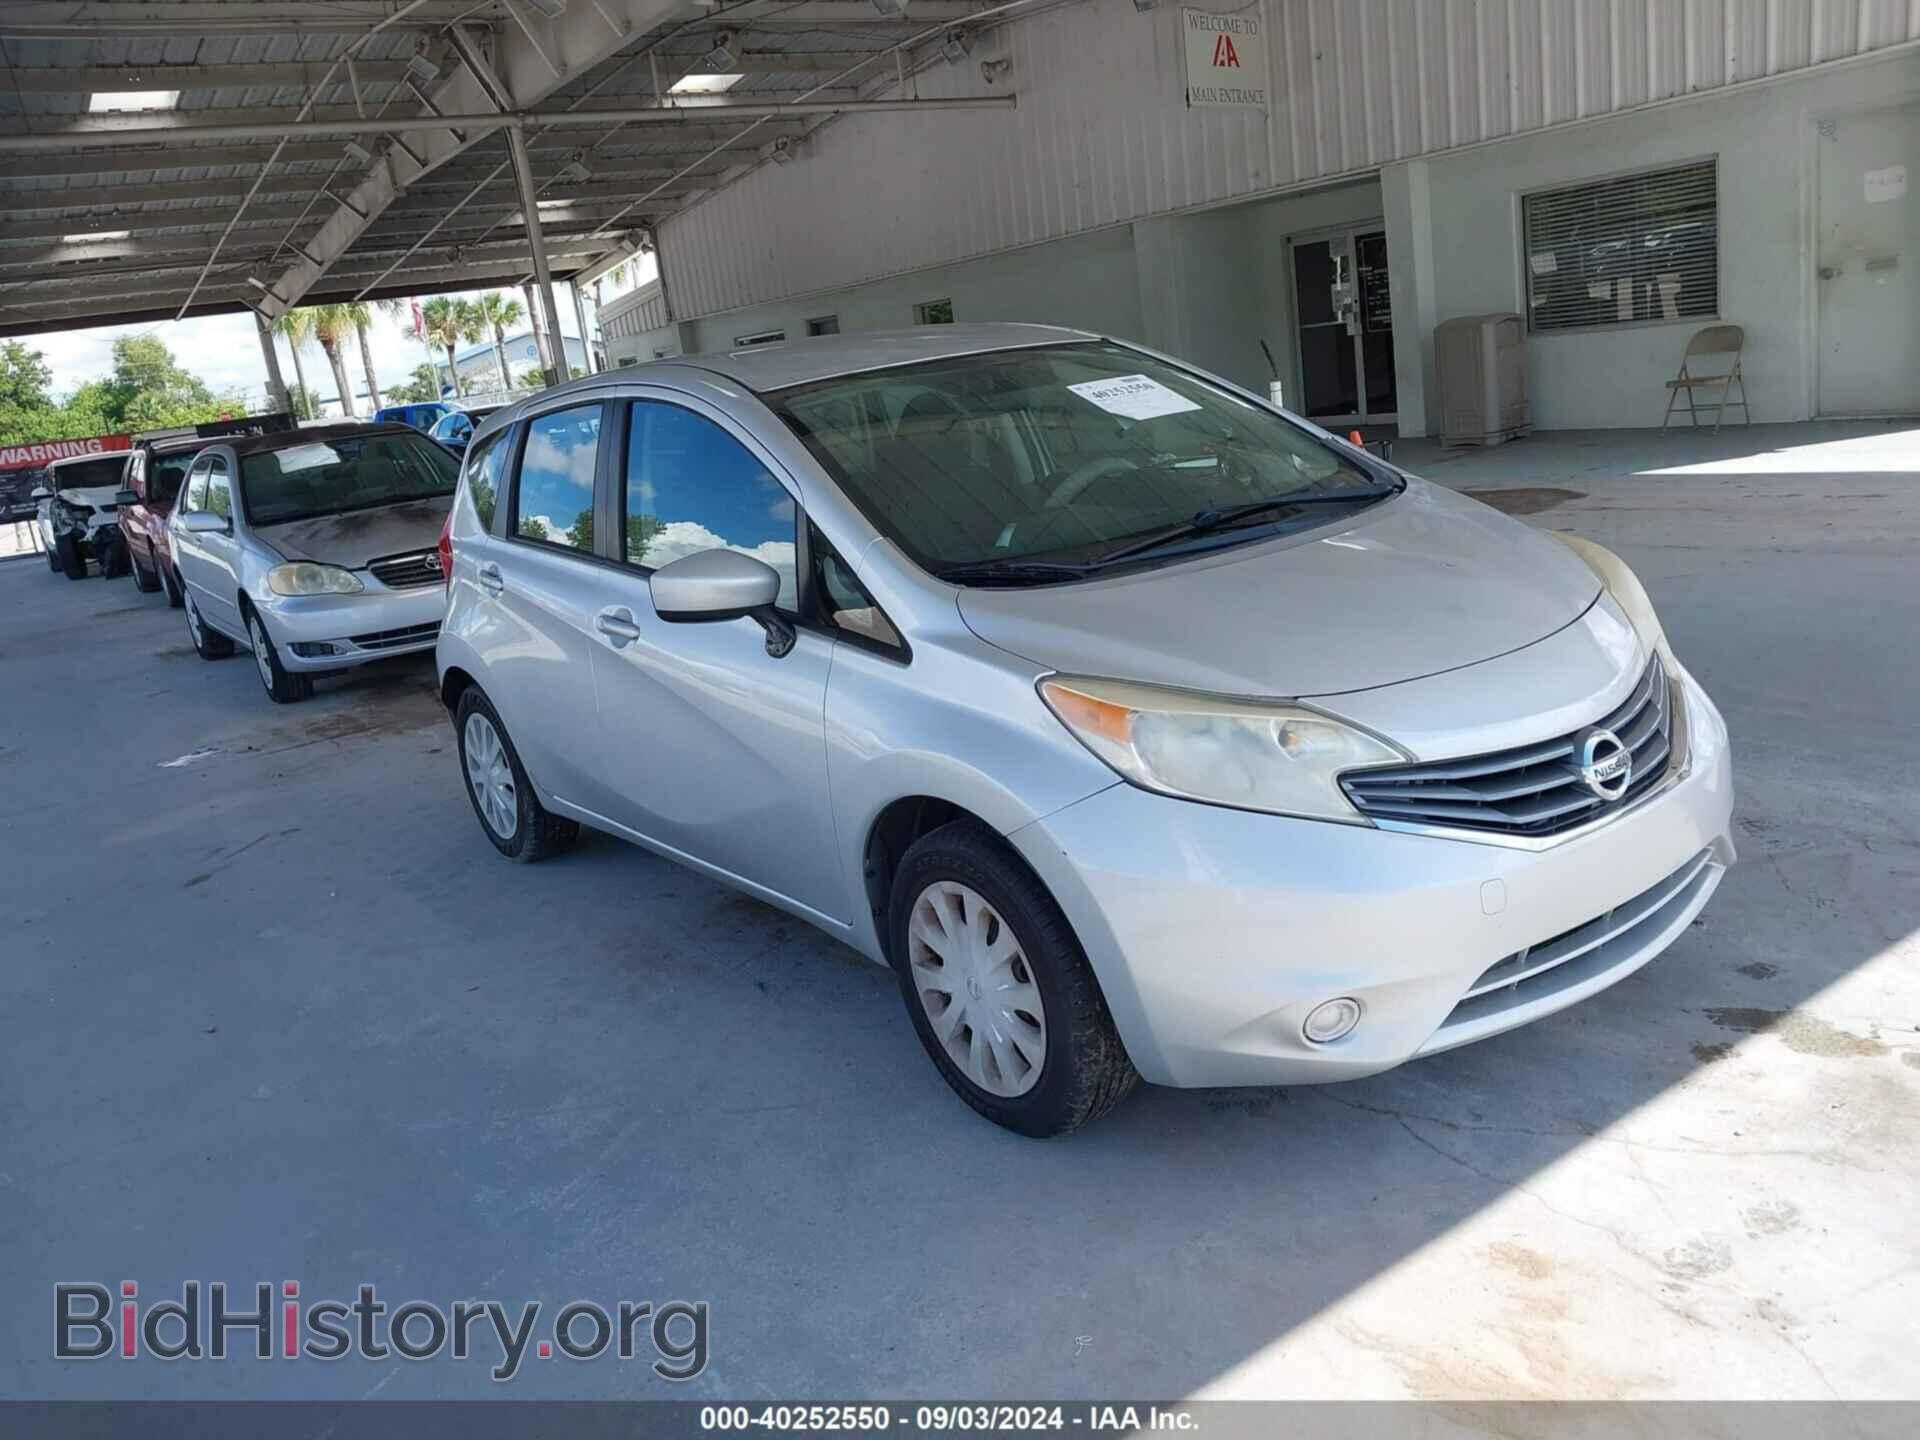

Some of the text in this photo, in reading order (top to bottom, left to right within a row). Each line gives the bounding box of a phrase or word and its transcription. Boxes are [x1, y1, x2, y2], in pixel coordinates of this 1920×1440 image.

[1189, 15, 1258, 35] WELCOME TO
[1191, 86, 1264, 104] MAIN ENTRANCE
[0, 439, 102, 465] WARNING
